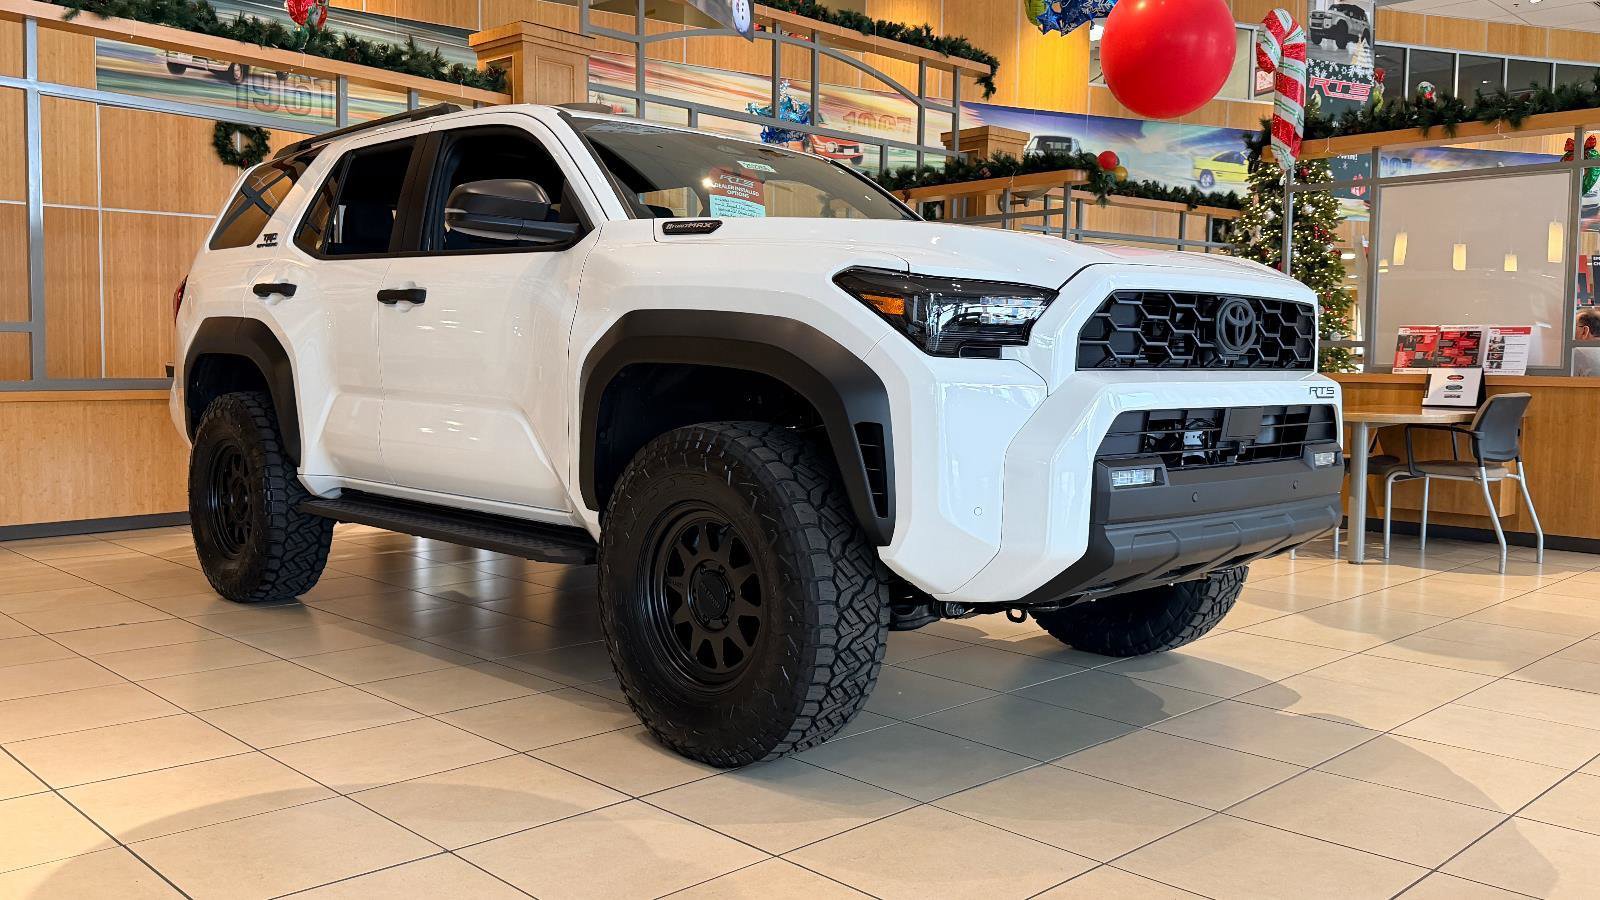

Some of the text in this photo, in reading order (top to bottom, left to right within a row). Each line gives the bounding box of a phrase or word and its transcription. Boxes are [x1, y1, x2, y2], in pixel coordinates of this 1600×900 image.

[235, 74, 333, 119] 1961
[1309, 76, 1371, 102] RTS
[726, 190, 750, 199] OPTIONS
[1309, 386, 1335, 399] RTS
